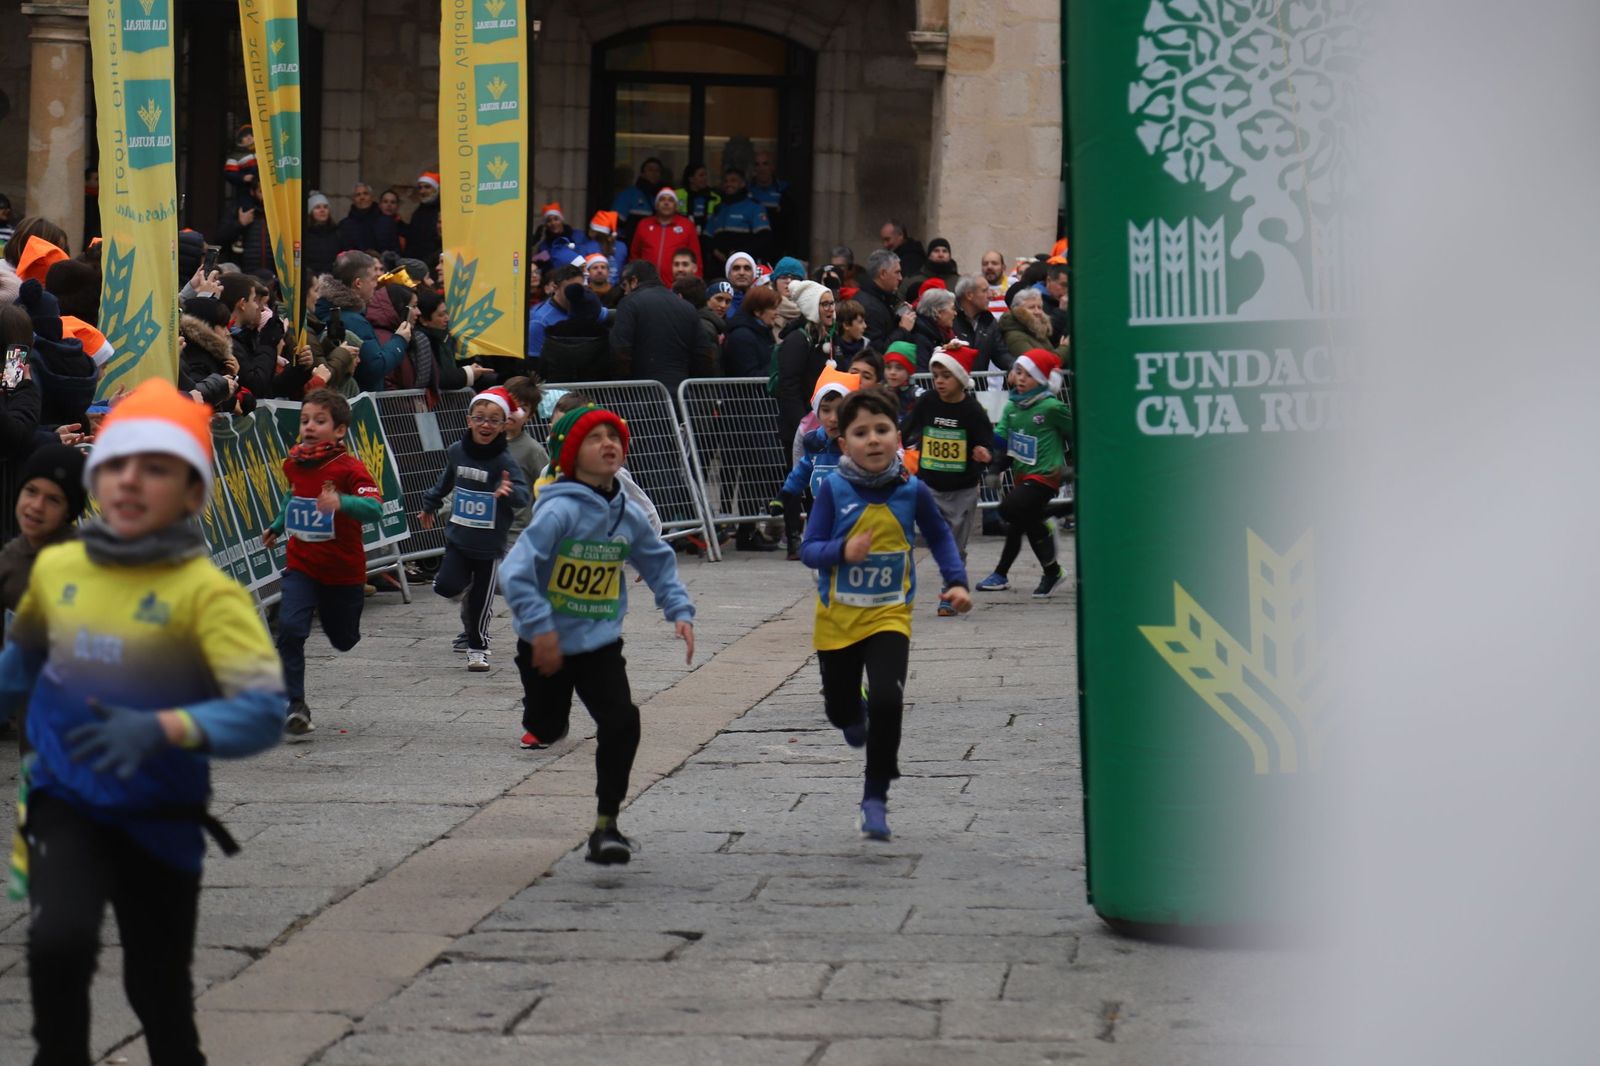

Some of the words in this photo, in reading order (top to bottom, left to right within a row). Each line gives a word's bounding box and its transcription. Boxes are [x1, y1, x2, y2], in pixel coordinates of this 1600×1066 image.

[934, 417, 958, 427] FREE
[1135, 394, 1249, 437] CAJA
[927, 440, 960, 459] 1883
[459, 499, 486, 516] 109
[292, 508, 324, 527] 112
[557, 562, 617, 595] 0927
[848, 566, 893, 588] 078
